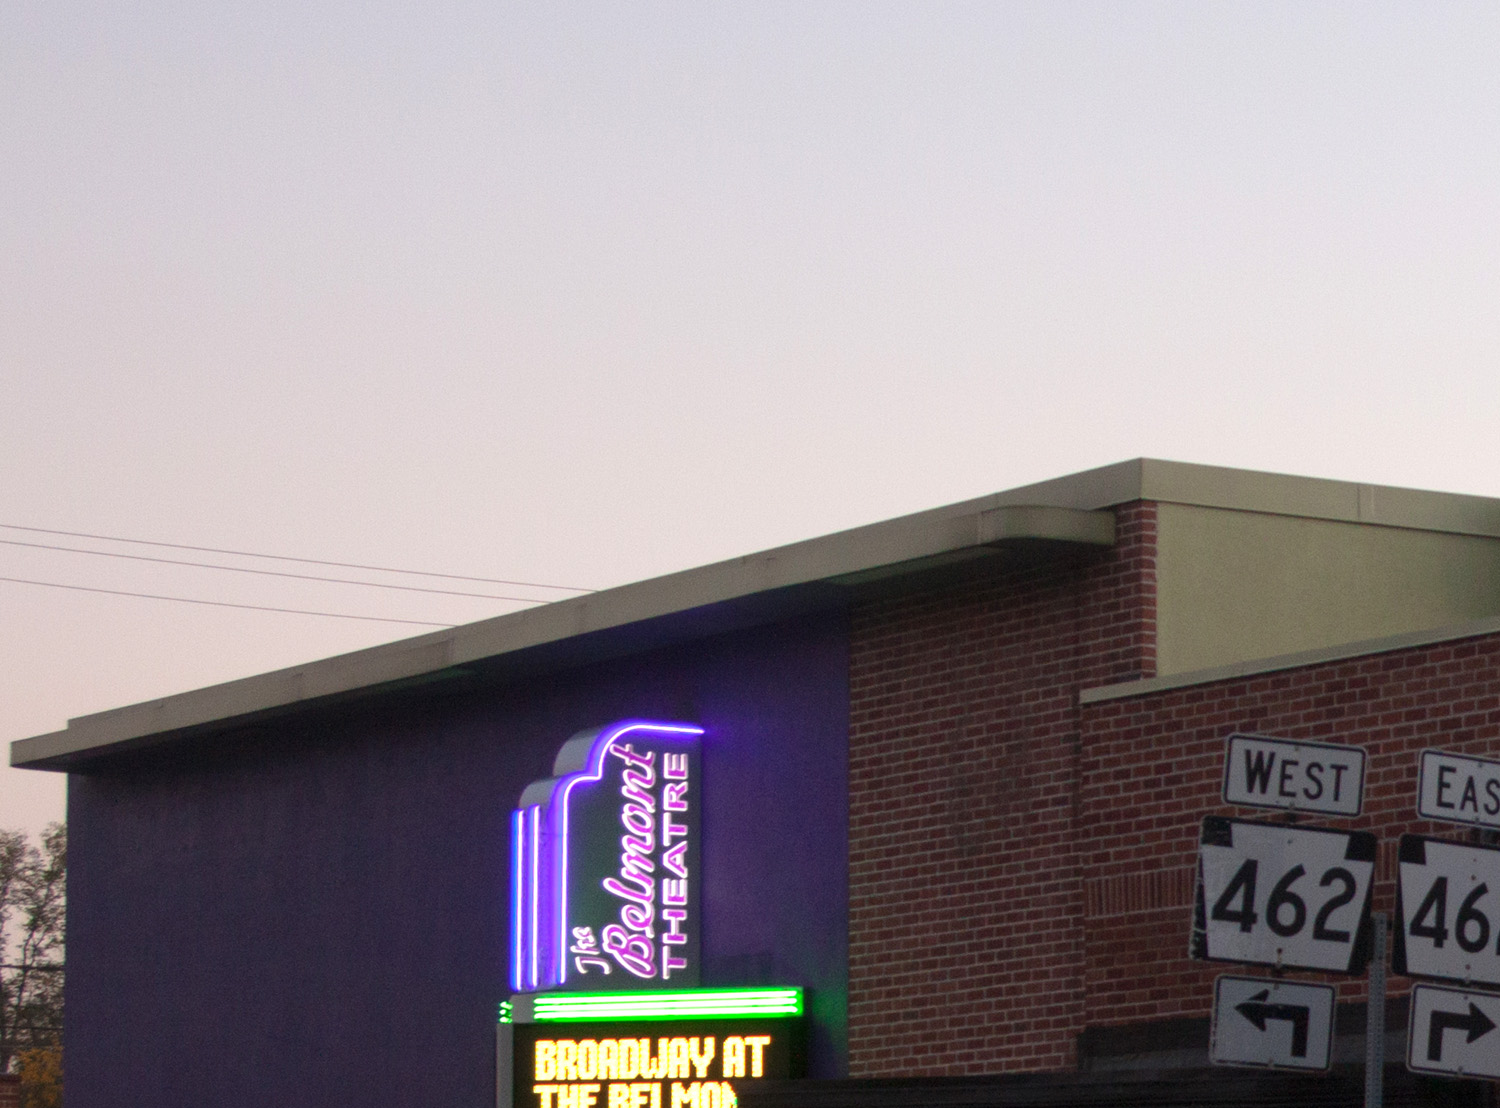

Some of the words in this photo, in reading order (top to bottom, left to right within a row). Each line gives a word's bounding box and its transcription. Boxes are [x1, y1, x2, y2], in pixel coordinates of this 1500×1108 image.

[1245, 750, 1348, 801] WEST
[602, 743, 656, 979] Belmont
[662, 752, 688, 979] THEATRE
[1211, 858, 1356, 943] 462
[534, 1036, 715, 1081] BROADWAY
[723, 1035, 770, 1077] AT
